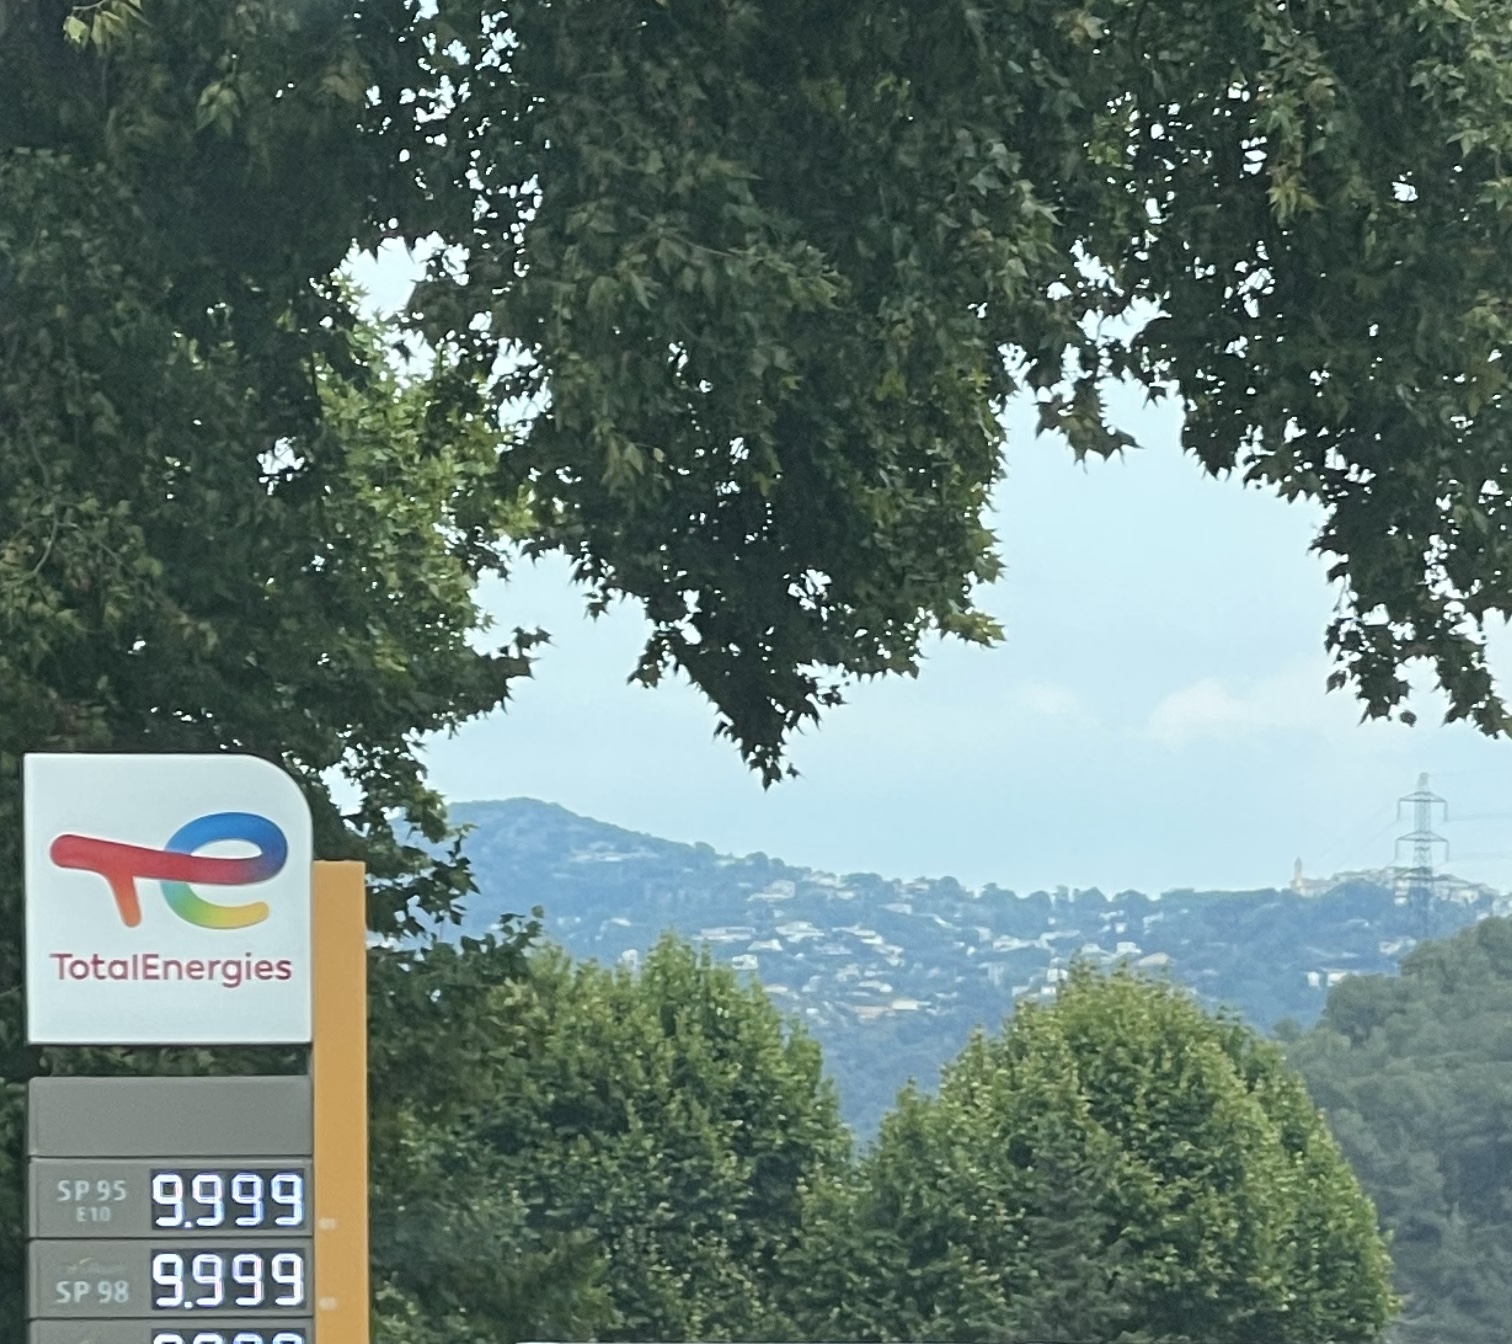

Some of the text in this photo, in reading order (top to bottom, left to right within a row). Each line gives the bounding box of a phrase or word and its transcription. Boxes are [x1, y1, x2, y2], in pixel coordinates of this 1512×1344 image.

[49, 953, 293, 988] TotalEnergies
[57, 1180, 127, 1202] SP 95
[152, 1173, 304, 1229] 9.999
[76, 1207, 111, 1222] E10
[56, 1281, 129, 1303] SP 98
[152, 1253, 305, 1309] 9.999
